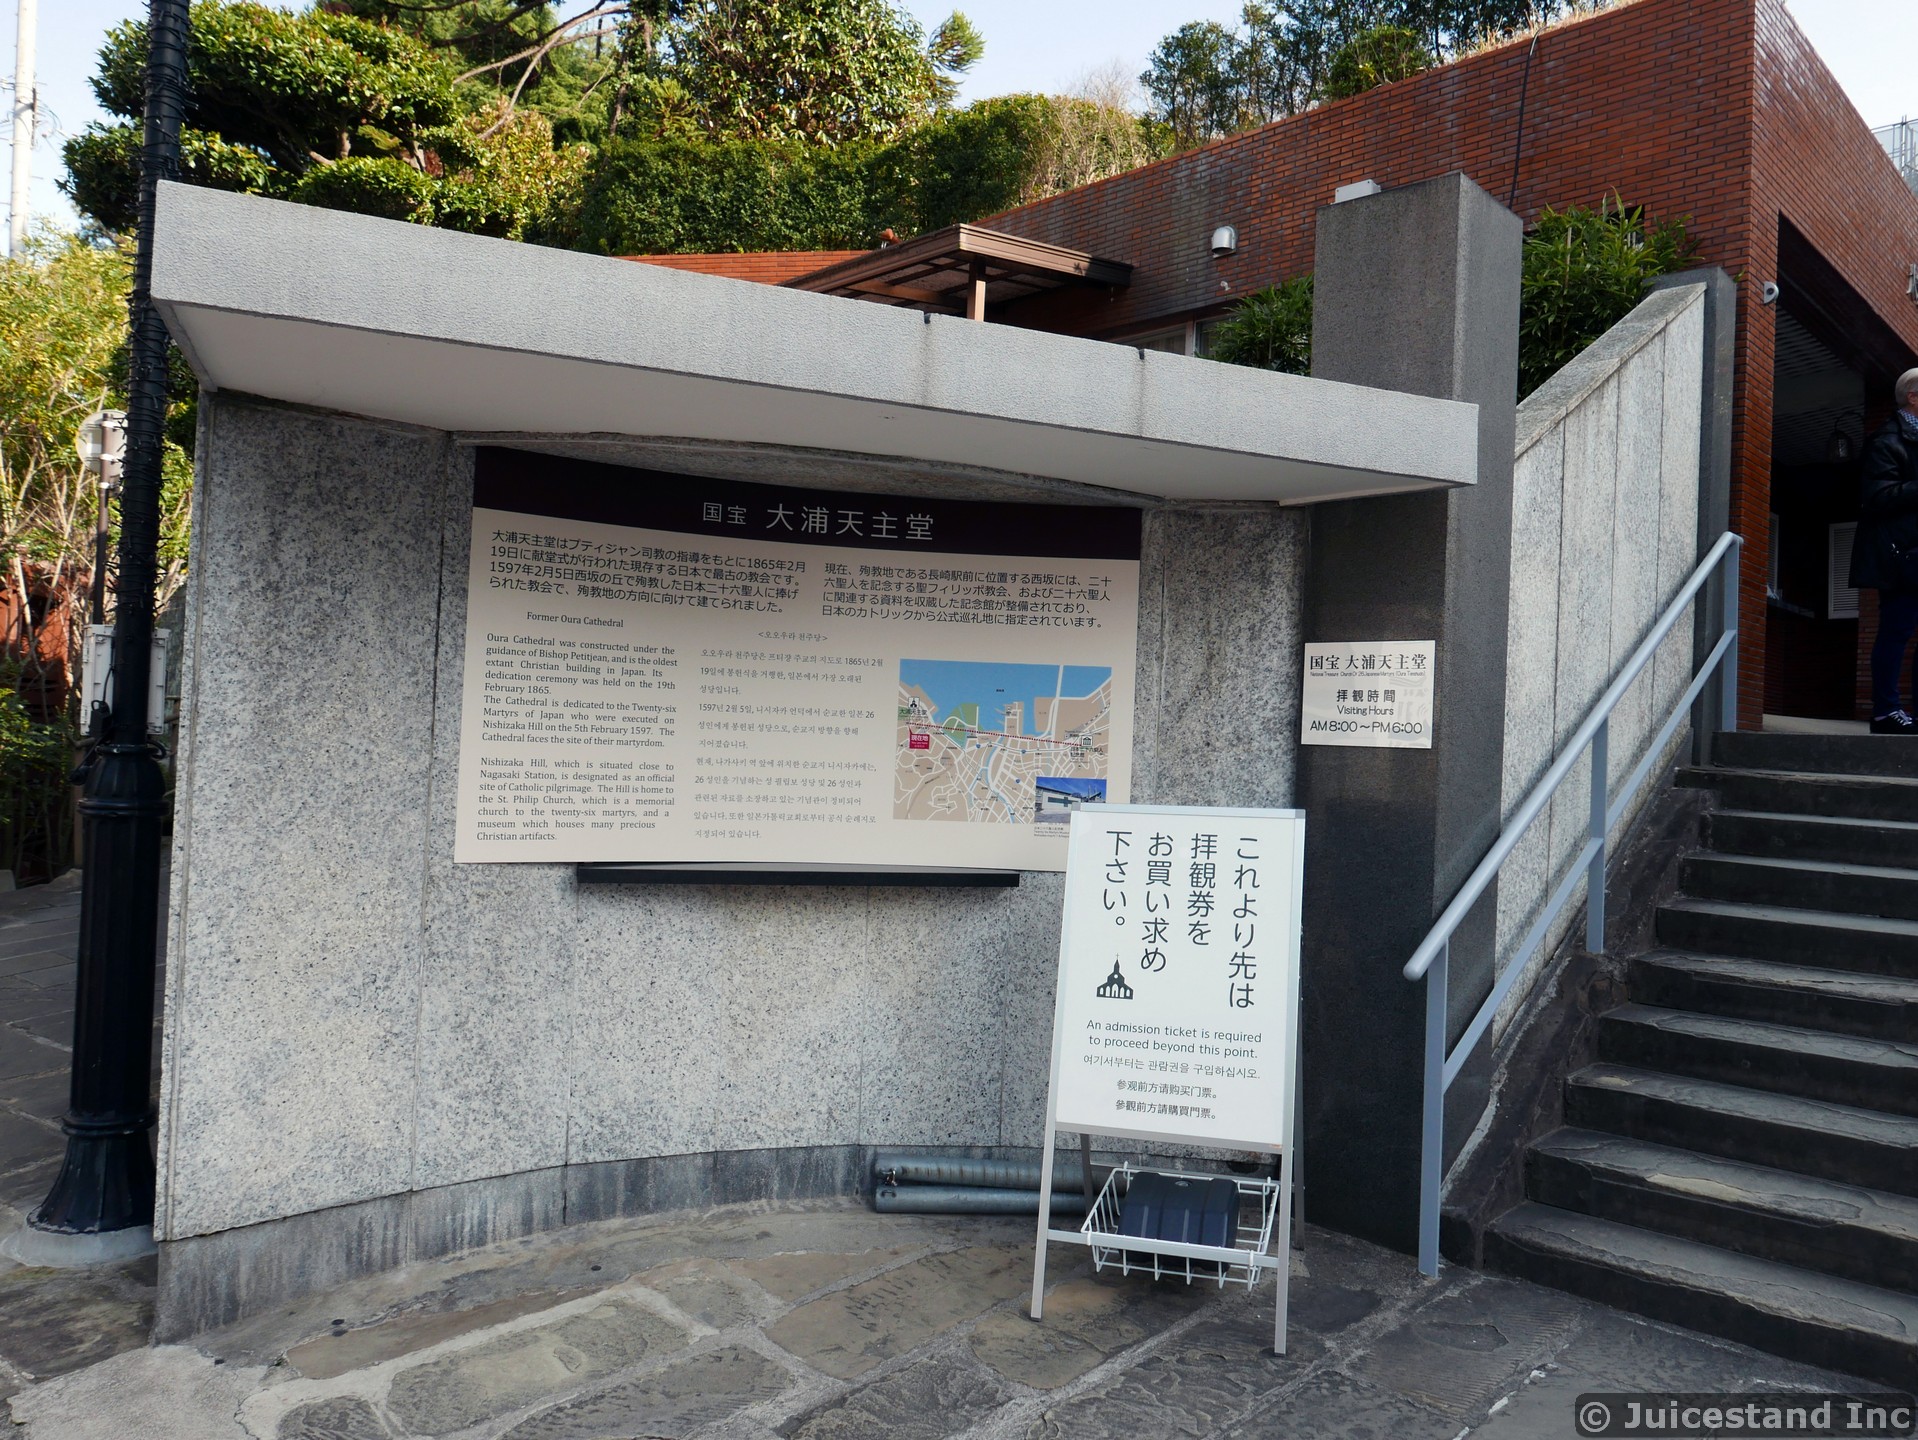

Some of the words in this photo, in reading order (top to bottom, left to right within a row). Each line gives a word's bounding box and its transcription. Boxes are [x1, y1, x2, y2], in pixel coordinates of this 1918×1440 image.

[703, 502, 747, 525] 国宝
[766, 503, 933, 541] 大浦天主堂
[490, 546, 800, 587] 19日に献堂式が行われた現存する日本で最古の教会です。
[489, 561, 799, 599] 1597年2月5日西坂の丘で殉教した日本二十六聖人に捧げ
[489, 576, 783, 613] られた教会で、殉教地の方向に向けて建てられました。
[527, 612, 559, 623] Former
[561, 615, 581, 624] Oura
[584, 617, 624, 627] Cathedral
[487, 633, 509, 643] Oura
[514, 635, 555, 646] Cathedral
[580, 641, 629, 651] constructed
[633, 645, 658, 654] under
[662, 646, 675, 654] the
[486, 646, 526, 656] guidance
[539, 650, 568, 660] Bishop
[570, 652, 610, 663] Petitjean,
[612, 654, 627, 663] and
[629, 655, 636, 663] is
[638, 656, 651, 664] the
[653, 658, 677, 666] oldest
[1310, 655, 1340, 670] 国宝
[1346, 653, 1427, 670] 大浦天主堂
[486, 659, 514, 668] extant
[520, 661, 559, 670] Christian
[566, 664, 600, 674] building
[607, 666, 615, 674] in
[621, 667, 646, 677] Japan.
[652, 669, 662, 677] Its
[485, 671, 532, 681] dedication
[536, 675, 578, 685] ceremony
[603, 678, 620, 687] held
[640, 679, 652, 688] the
[657, 681, 675, 689] 19th
[485, 683, 524, 694] February
[528, 686, 551, 694] 1865.
[484, 696, 501, 704] The
[506, 697, 547, 706] Cathedral
[552, 699, 559, 707] is
[563, 700, 604, 709] dedicated
[617, 702, 630, 710] the
[632, 703, 676, 713] Twenty-six
[1336, 689, 1396, 703] 拝観時間
[484, 708, 518, 718] Martyrs
[525, 710, 534, 718] of
[540, 711, 564, 720] Japan
[571, 712, 589, 720] who
[622, 715, 658, 724] executed
[1337, 705, 1367, 717] Visiting
[1368, 706, 1394, 716] Hours
[483, 720, 525, 730] Nishizaka
[528, 722, 543, 730] Hill
[558, 724, 572, 732] the
[575, 724, 588, 733] 5th
[590, 725, 628, 735] February
[631, 727, 653, 735] 1597.
[660, 728, 675, 736] The
[482, 733, 524, 742] Cathedral
[527, 734, 548, 743] faces
[551, 735, 564, 743] the
[567, 736, 581, 744] site
[584, 736, 594, 744] of
[594, 737, 614, 745] their
[616, 738, 664, 748] martyrdom.
[481, 758, 524, 766] Nishizaka
[530, 759, 548, 768] Hill,
[555, 760, 579, 768] which
[600, 761, 633, 770] situated
[639, 762, 659, 770] close
[480, 770, 519, 780] Nagasaki
[525, 771, 557, 781] Station,
[562, 772, 568, 780] is
[572, 772, 618, 782] designated
[647, 774, 675, 782] official
[479, 783, 495, 791] site
[498, 783, 508, 791] of
[509, 783, 543, 791] Catholic
[546, 784, 592, 794] pilgrimage.
[598, 785, 613, 793] The
[616, 785, 629, 793] Hill
[632, 785, 639, 793] is
[641, 785, 663, 793] home
[479, 795, 493, 803] the
[497, 795, 508, 803] St.
[514, 795, 539, 805] Philip
[543, 796, 575, 805] Church,
[582, 796, 607, 804] which
[635, 797, 675, 805] memorial
[478, 807, 508, 816] church
[531, 808, 544, 816] the
[552, 808, 595, 818] twenty-six
[602, 809, 637, 818] martyrs,
[643, 808, 658, 817] and
[523, 819, 548, 828] which
[555, 820, 584, 828] houses
[591, 821, 614, 830] many
[620, 821, 655, 830] precious
[477, 832, 517, 840] Christian
[519, 832, 557, 840] artifacts.
[1103, 830, 1133, 926] 下さい。
[1187, 833, 1218, 946] 拝観券を
[1140, 832, 1174, 973] お買い求め
[1229, 837, 1260, 1009] これより先は
[1087, 1020, 1101, 1030] An
[1105, 1022, 1160, 1035] admission
[1165, 1026, 1197, 1038] ticket
[1201, 1029, 1210, 1039] is
[1215, 1031, 1261, 1043] required
[1089, 1036, 1100, 1045] to
[1105, 1037, 1148, 1049] proceed
[1153, 1040, 1194, 1054] beyond
[1199, 1044, 1220, 1055] this
[1224, 1047, 1257, 1059] point.
[1084, 1055, 1144, 1070] 여기서부터는
[1149, 1061, 1189, 1074] 관람권을
[1193, 1064, 1260, 1079] 구입하십시오.
[1117, 1079, 1217, 1098] 参观前方请购买门票。
[1116, 1100, 1215, 1119] 參觀前方請購買門票。
